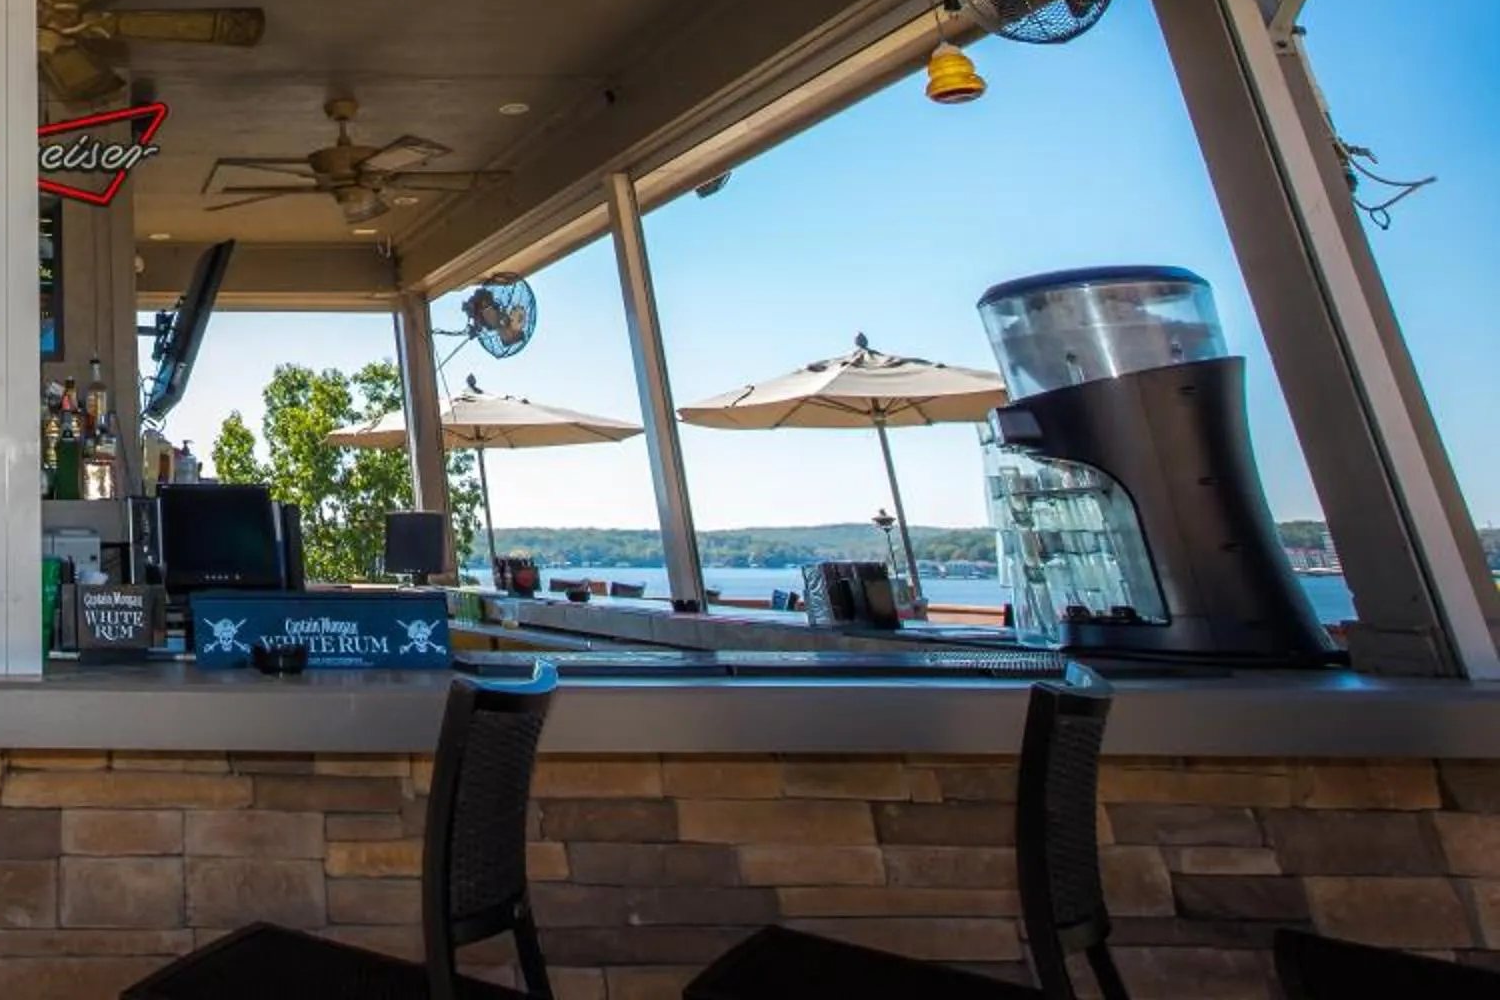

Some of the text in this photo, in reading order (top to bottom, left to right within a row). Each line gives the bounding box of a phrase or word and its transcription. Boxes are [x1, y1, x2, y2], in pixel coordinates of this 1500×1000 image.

[85, 610, 143, 627] WHITE
[95, 625, 133, 640] RUM
[337, 635, 389, 653] RUM
